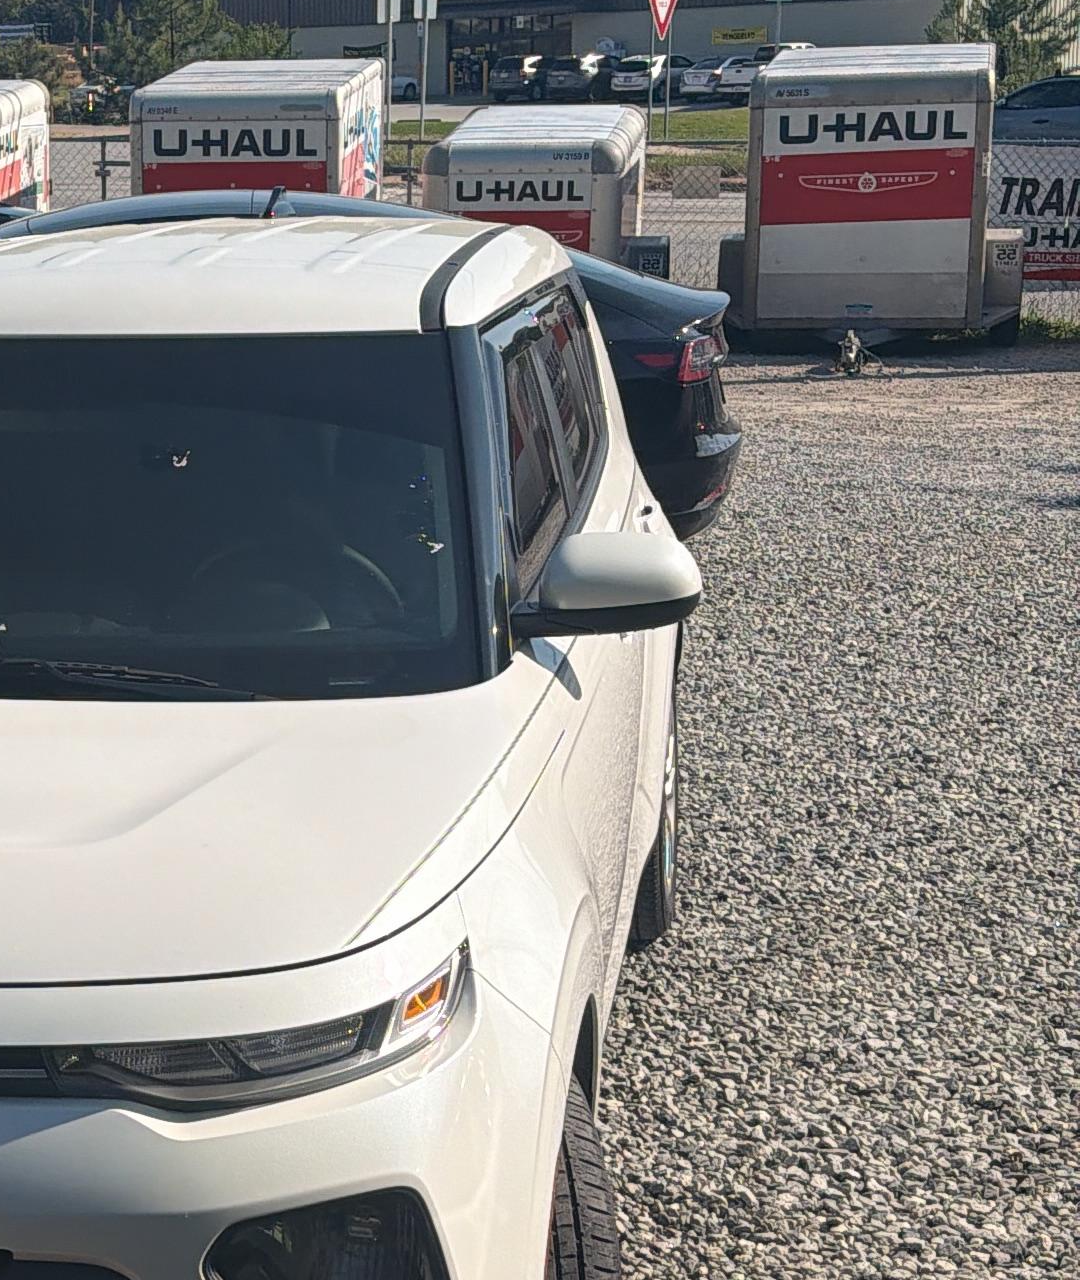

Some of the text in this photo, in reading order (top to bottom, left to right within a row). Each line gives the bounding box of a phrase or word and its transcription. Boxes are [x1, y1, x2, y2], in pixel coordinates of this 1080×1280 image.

[779, 110, 968, 144] U-HAUL
[153, 129, 317, 157] U-HAUL
[456, 180, 584, 202] U-HAUL
[999, 176, 1080, 216] TRAI
[1028, 253, 1063, 263] TRUCK
